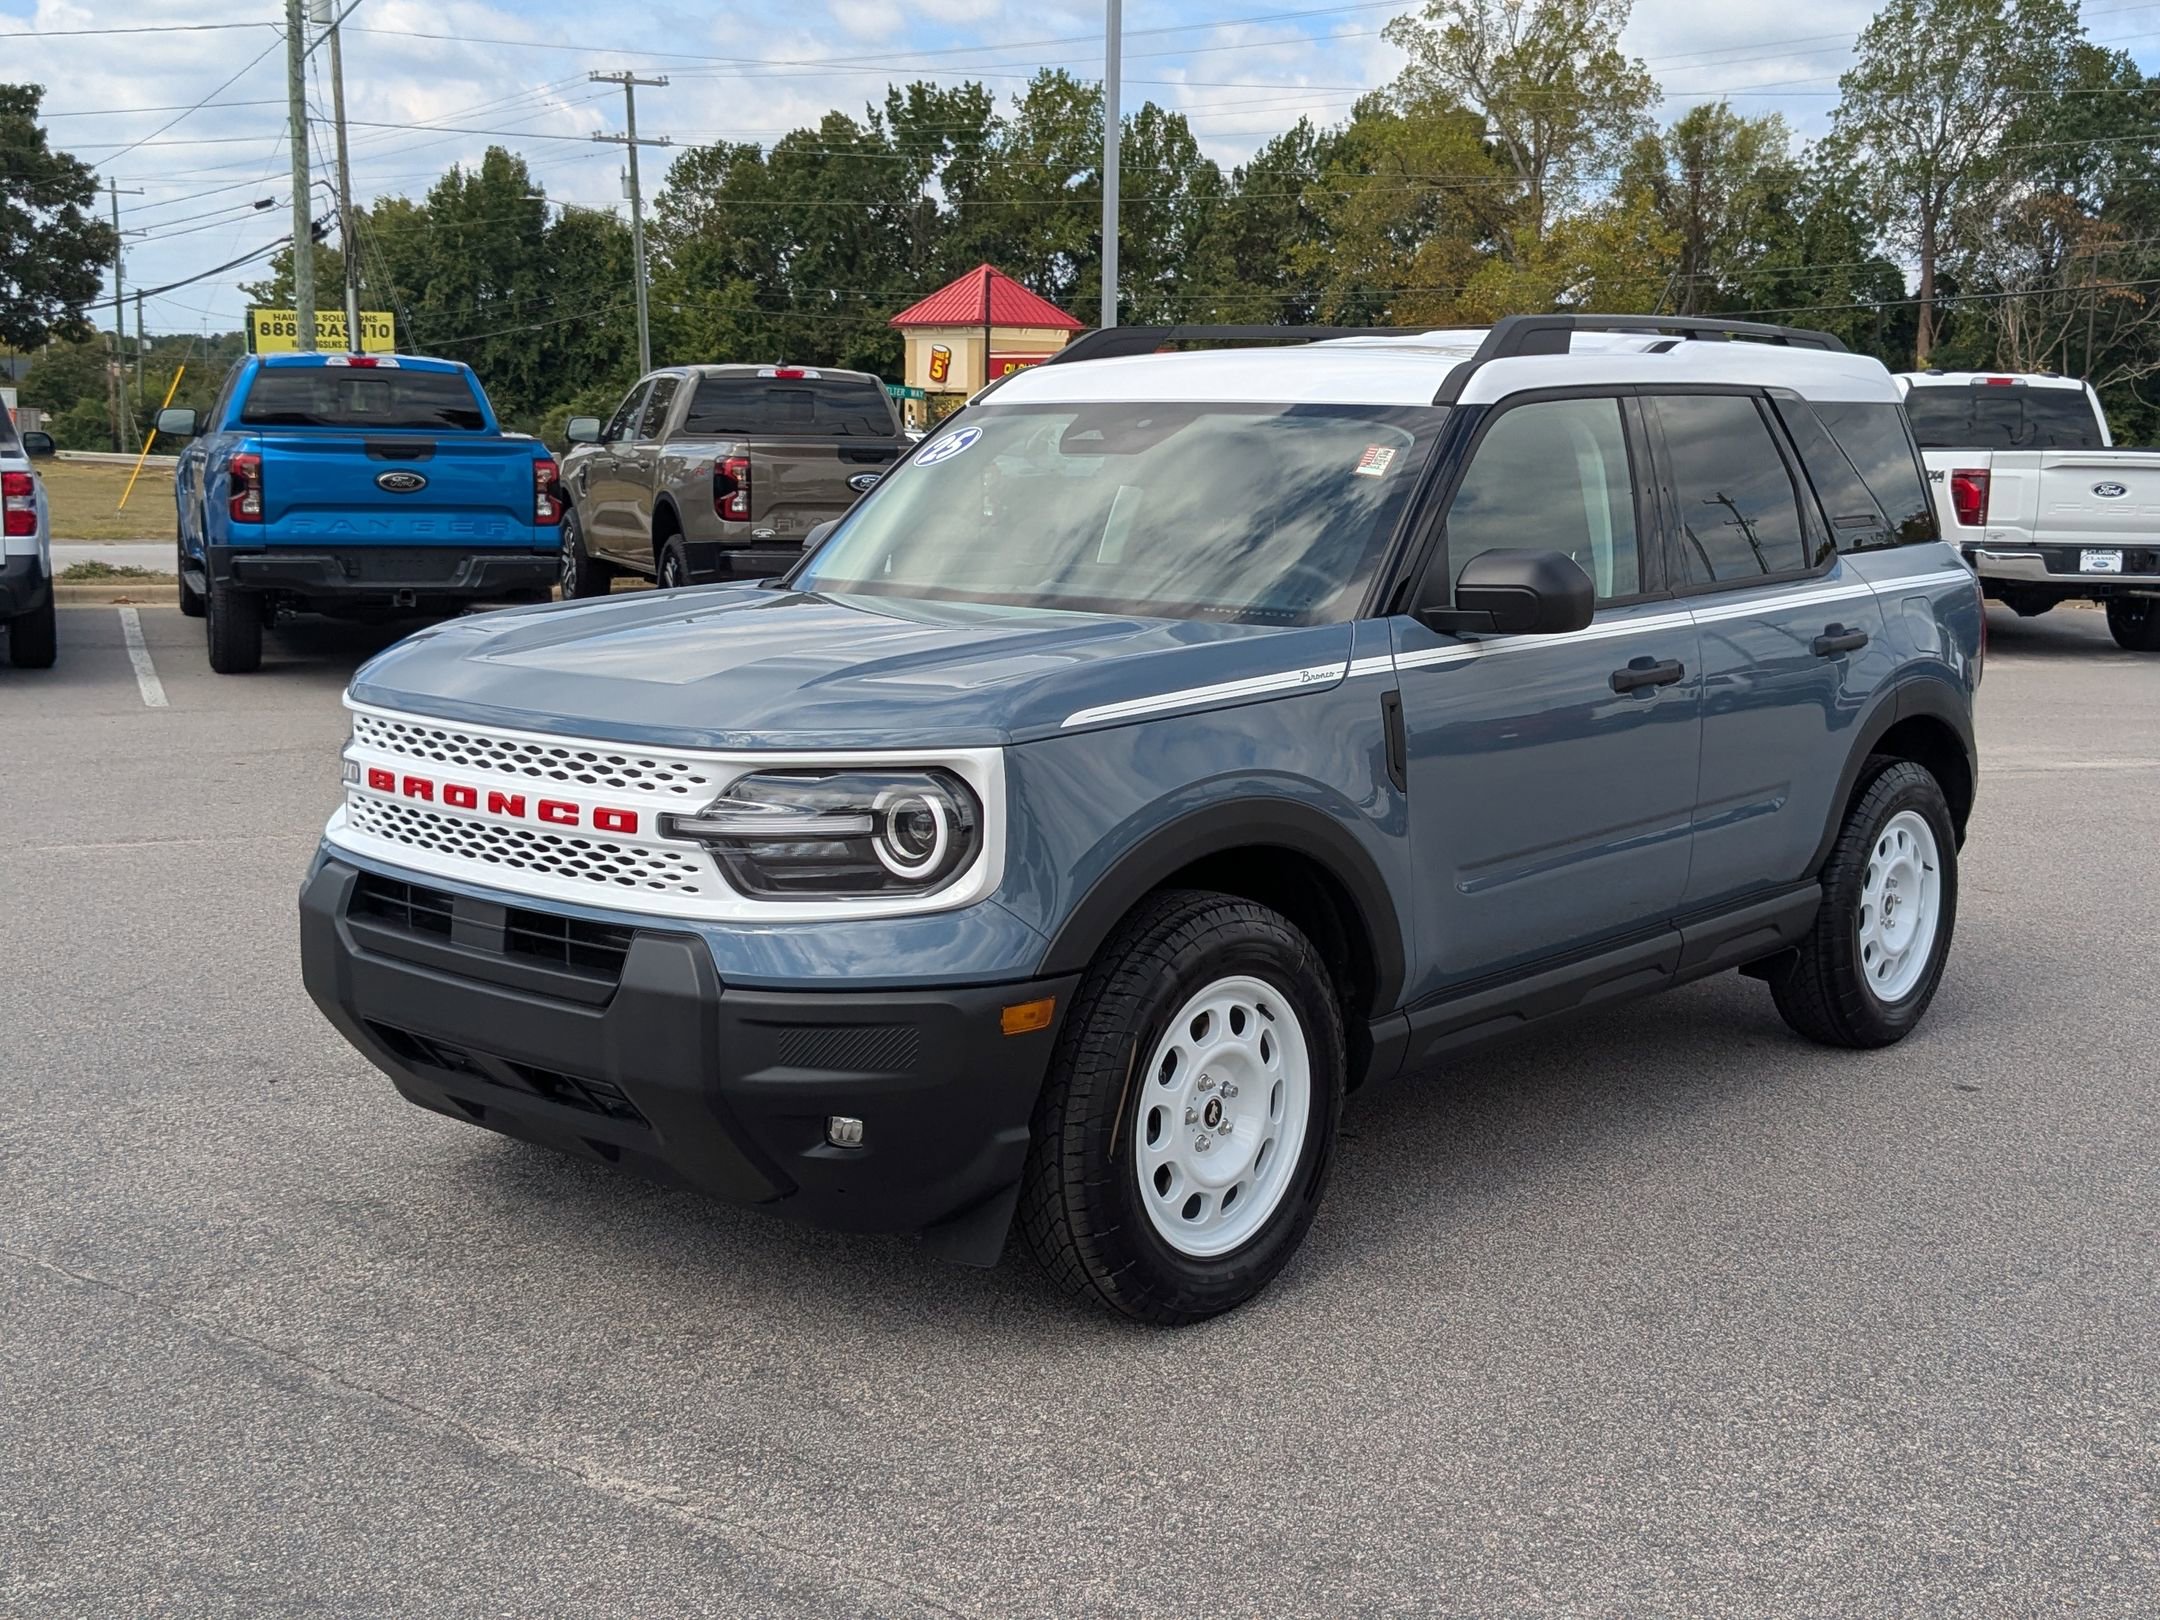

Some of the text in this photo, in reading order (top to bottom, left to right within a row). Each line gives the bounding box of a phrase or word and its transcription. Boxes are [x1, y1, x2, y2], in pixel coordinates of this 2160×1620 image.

[932, 360, 942, 378] 5
[911, 389, 924, 398] WAY
[918, 430, 978, 464] 25
[289, 520, 512, 535] RANGER
[1300, 671, 1336, 683] Bronco
[368, 767, 638, 834] BRONCO
